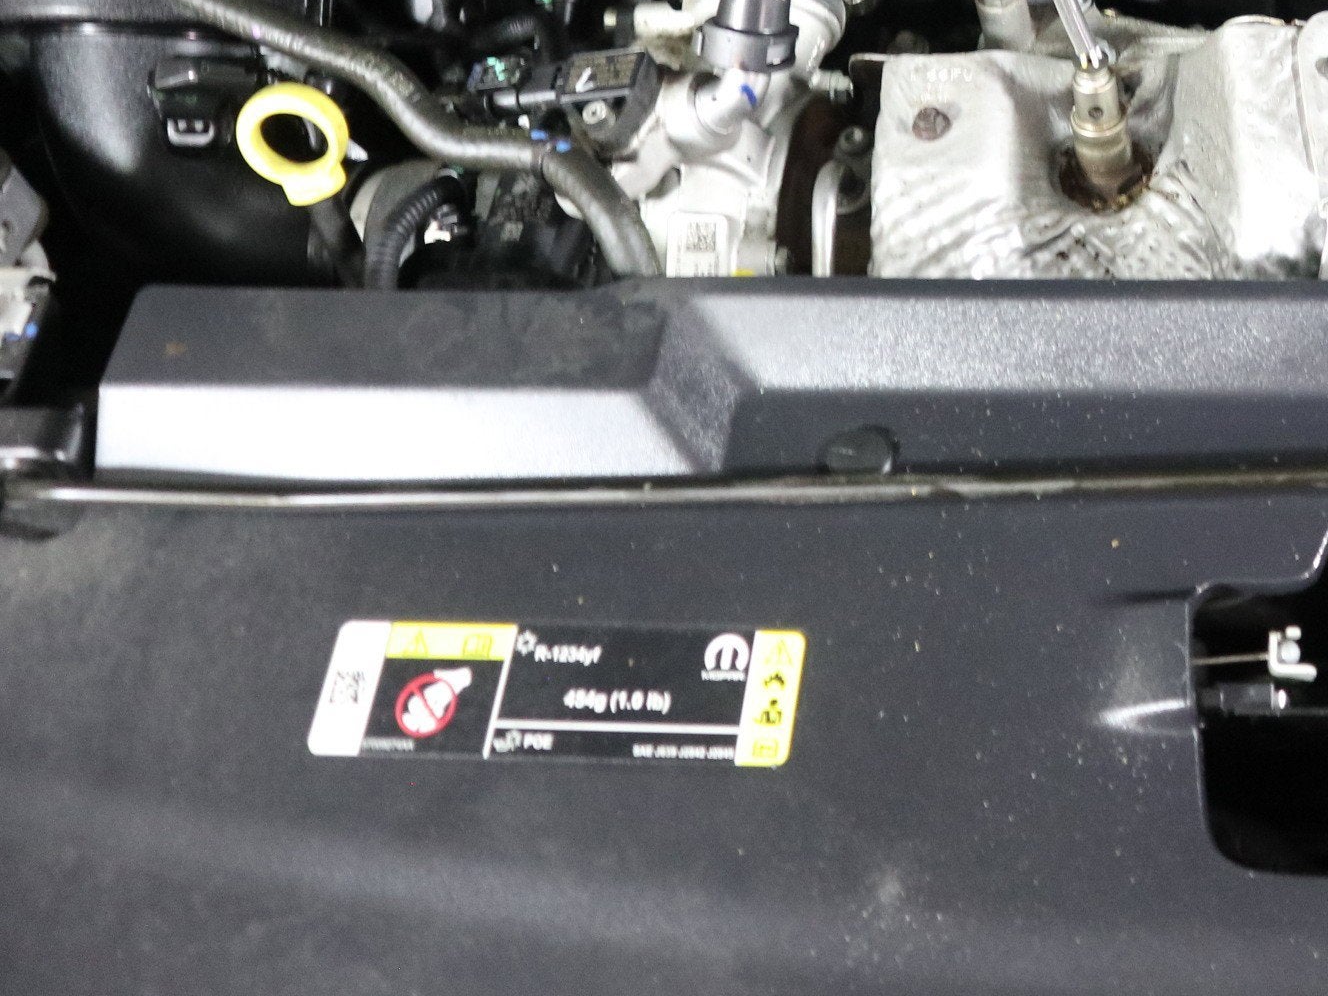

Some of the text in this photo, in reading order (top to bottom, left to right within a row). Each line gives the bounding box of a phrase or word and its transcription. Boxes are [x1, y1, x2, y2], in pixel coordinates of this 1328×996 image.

[534, 643, 602, 666] R-1234yf
[610, 689, 644, 714] (1.0
[646, 689, 672, 715] lb)
